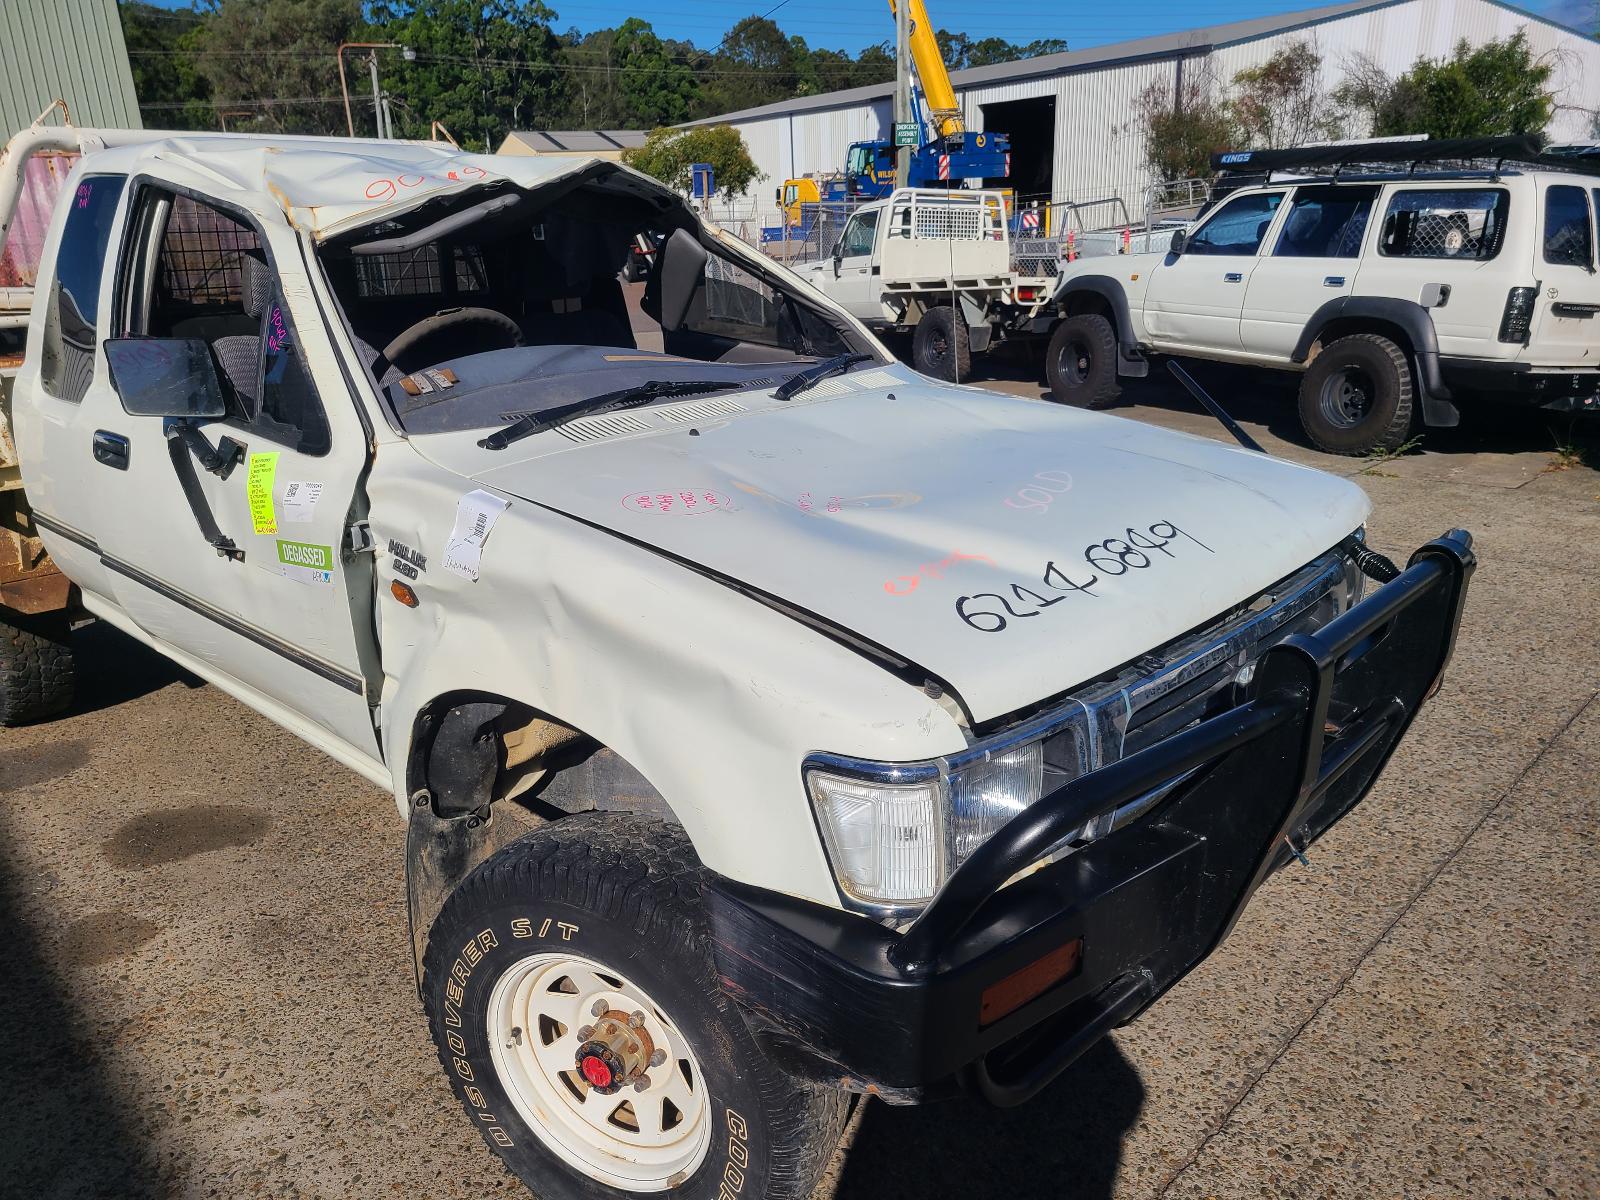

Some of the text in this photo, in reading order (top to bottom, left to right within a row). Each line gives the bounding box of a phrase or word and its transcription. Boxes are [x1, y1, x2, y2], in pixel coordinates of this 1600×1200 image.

[1221, 153, 1252, 163] KINGS
[877, 170, 897, 178] WILSO
[282, 543, 325, 566] DEGASSED
[387, 538, 427, 573] HILUX
[445, 918, 579, 1147] DISCOVERER S/T
